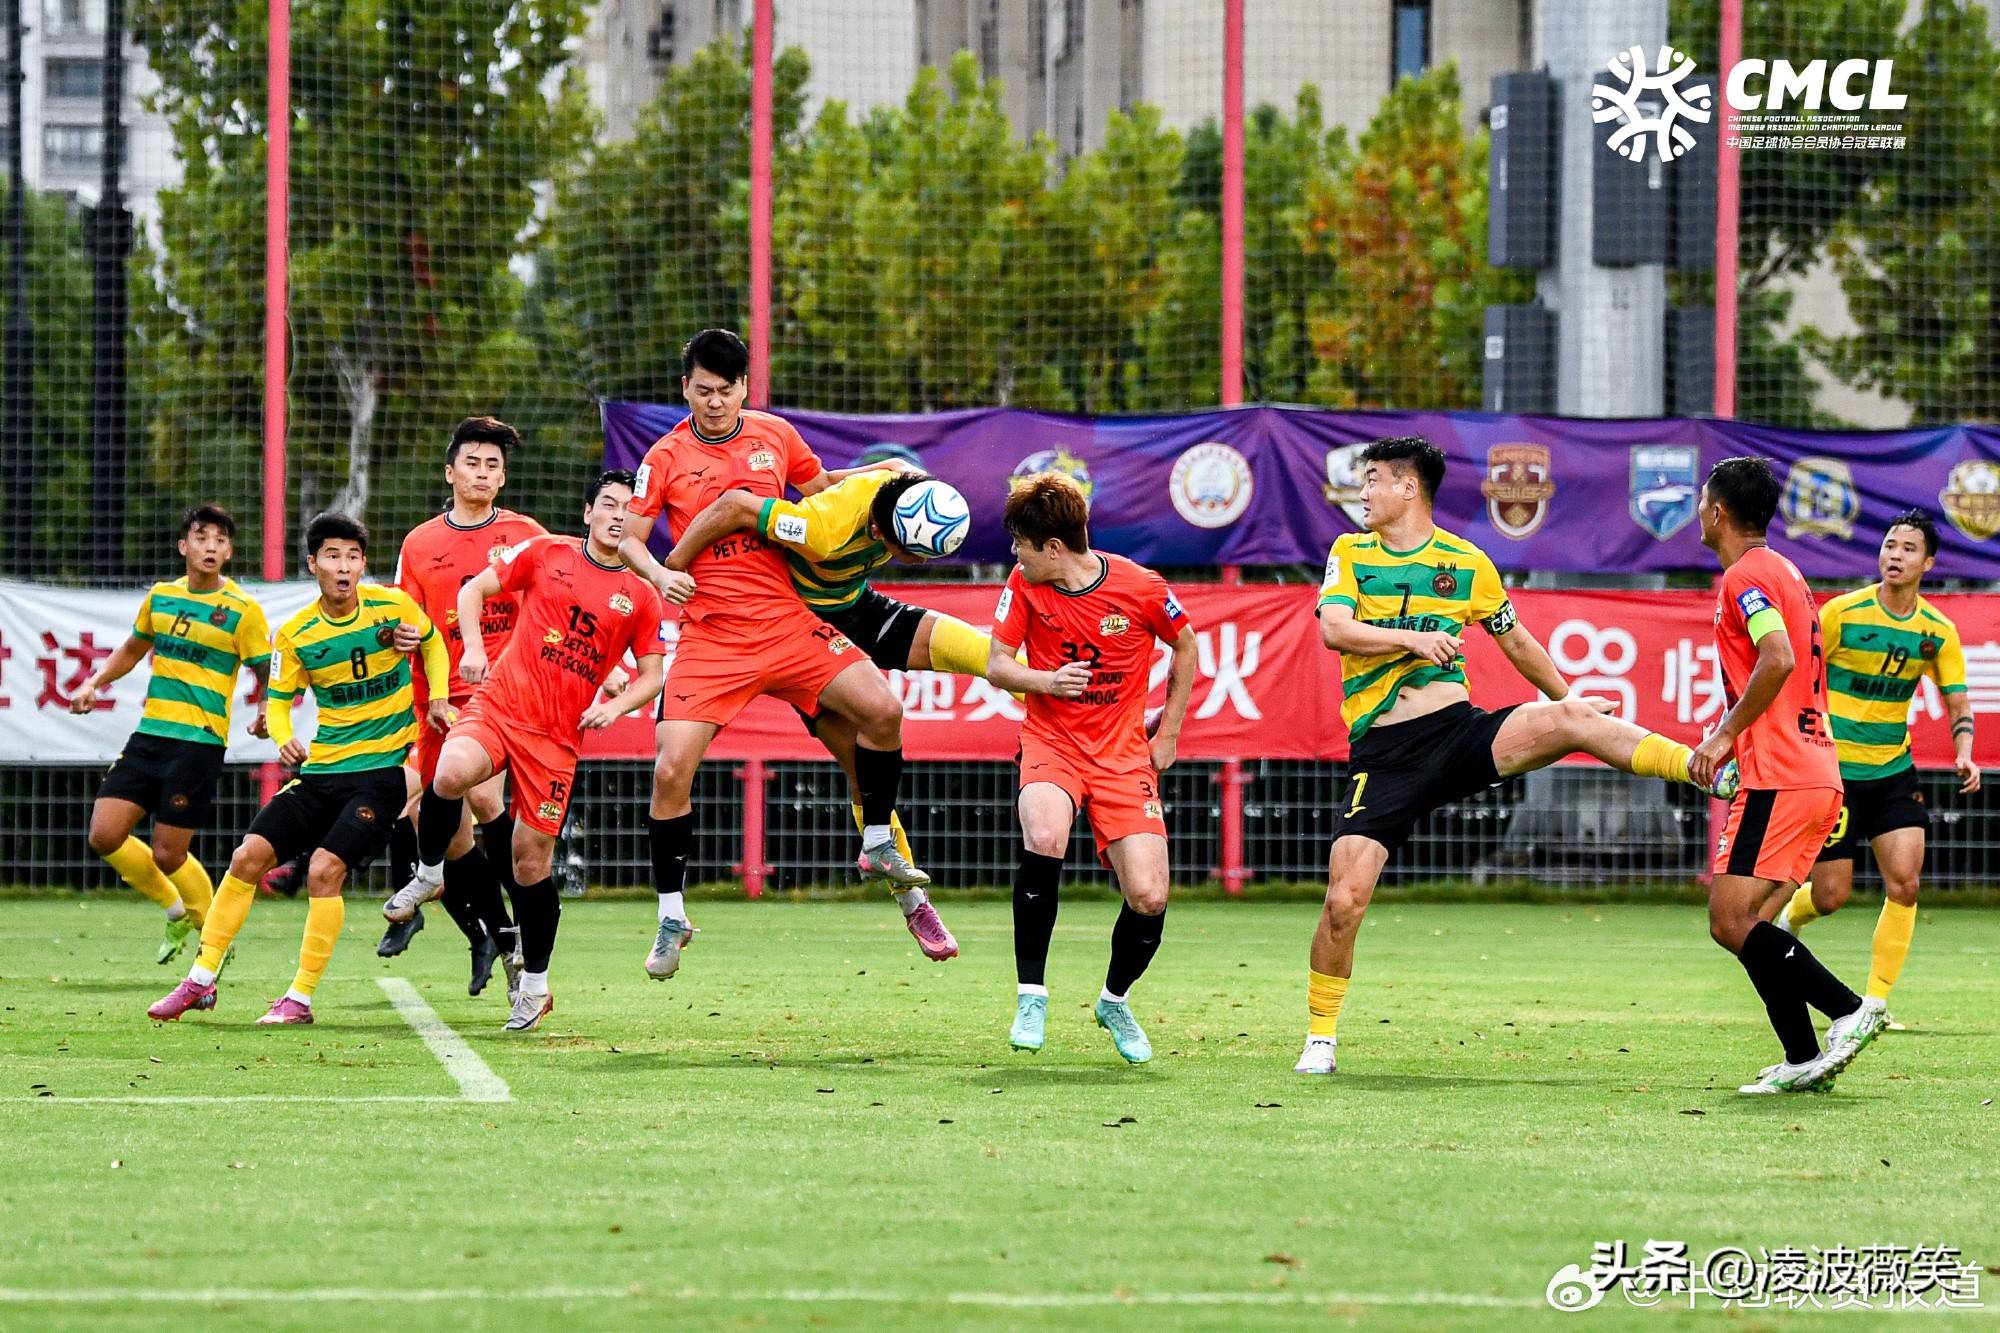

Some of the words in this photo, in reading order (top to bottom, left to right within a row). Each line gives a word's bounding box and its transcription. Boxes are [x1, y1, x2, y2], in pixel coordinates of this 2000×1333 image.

[713, 540, 737, 560] PET
[1394, 582, 1412, 617] 7
[170, 608, 199, 638] 15
[568, 605, 598, 638] 15
[811, 625, 840, 641] 12
[350, 646, 368, 680] 8
[541, 646, 564, 665] PET
[562, 655, 598, 685] SCHOOL
[1060, 642, 1104, 670] 32
[1880, 642, 1910, 677] 19
[549, 780, 567, 803] 15
